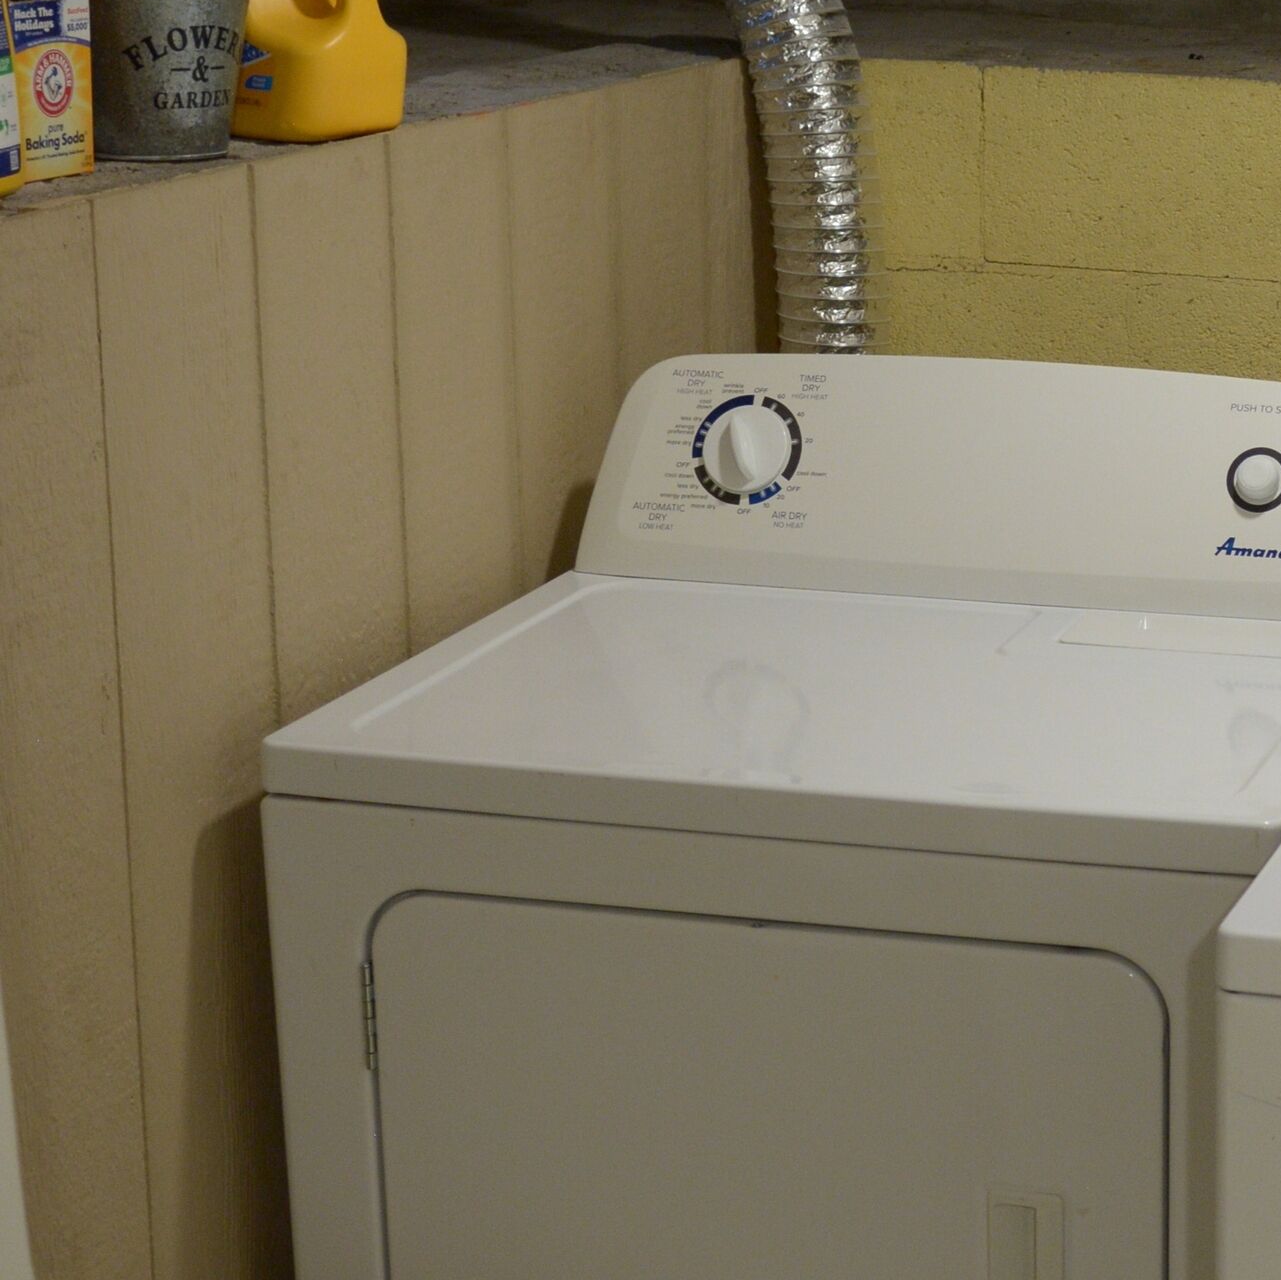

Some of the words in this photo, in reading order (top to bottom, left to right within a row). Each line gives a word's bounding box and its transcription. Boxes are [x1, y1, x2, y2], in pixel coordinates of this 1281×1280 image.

[14, 8, 37, 20] Hack
[37, 6, 54, 18] The
[14, 20, 54, 32] Holidays
[122, 24, 241, 71] FLOWER
[36, 65, 45, 92] ARM
[42, 58, 49, 68] &
[49, 53, 72, 87] HAMMER
[153, 88, 232, 111] GARDEN
[48, 124, 64, 135] pure
[26, 135, 60, 150] Baking
[62, 130, 85, 146] Soda
[672, 369, 724, 380] AUTOMATIC
[800, 374, 827, 383] TIMED
[687, 378, 706, 387] DRY
[802, 384, 821, 392] DRY
[695, 388, 713, 396] HEAT
[1230, 403, 1258, 412] PUSH
[1260, 404, 1273, 414] TO
[632, 502, 685, 512] AUTOMATIC
[648, 512, 668, 521] DRY
[771, 510, 787, 520] AIR
[788, 512, 808, 521] DRY
[638, 522, 654, 530] LOW
[654, 523, 674, 531] HEAT
